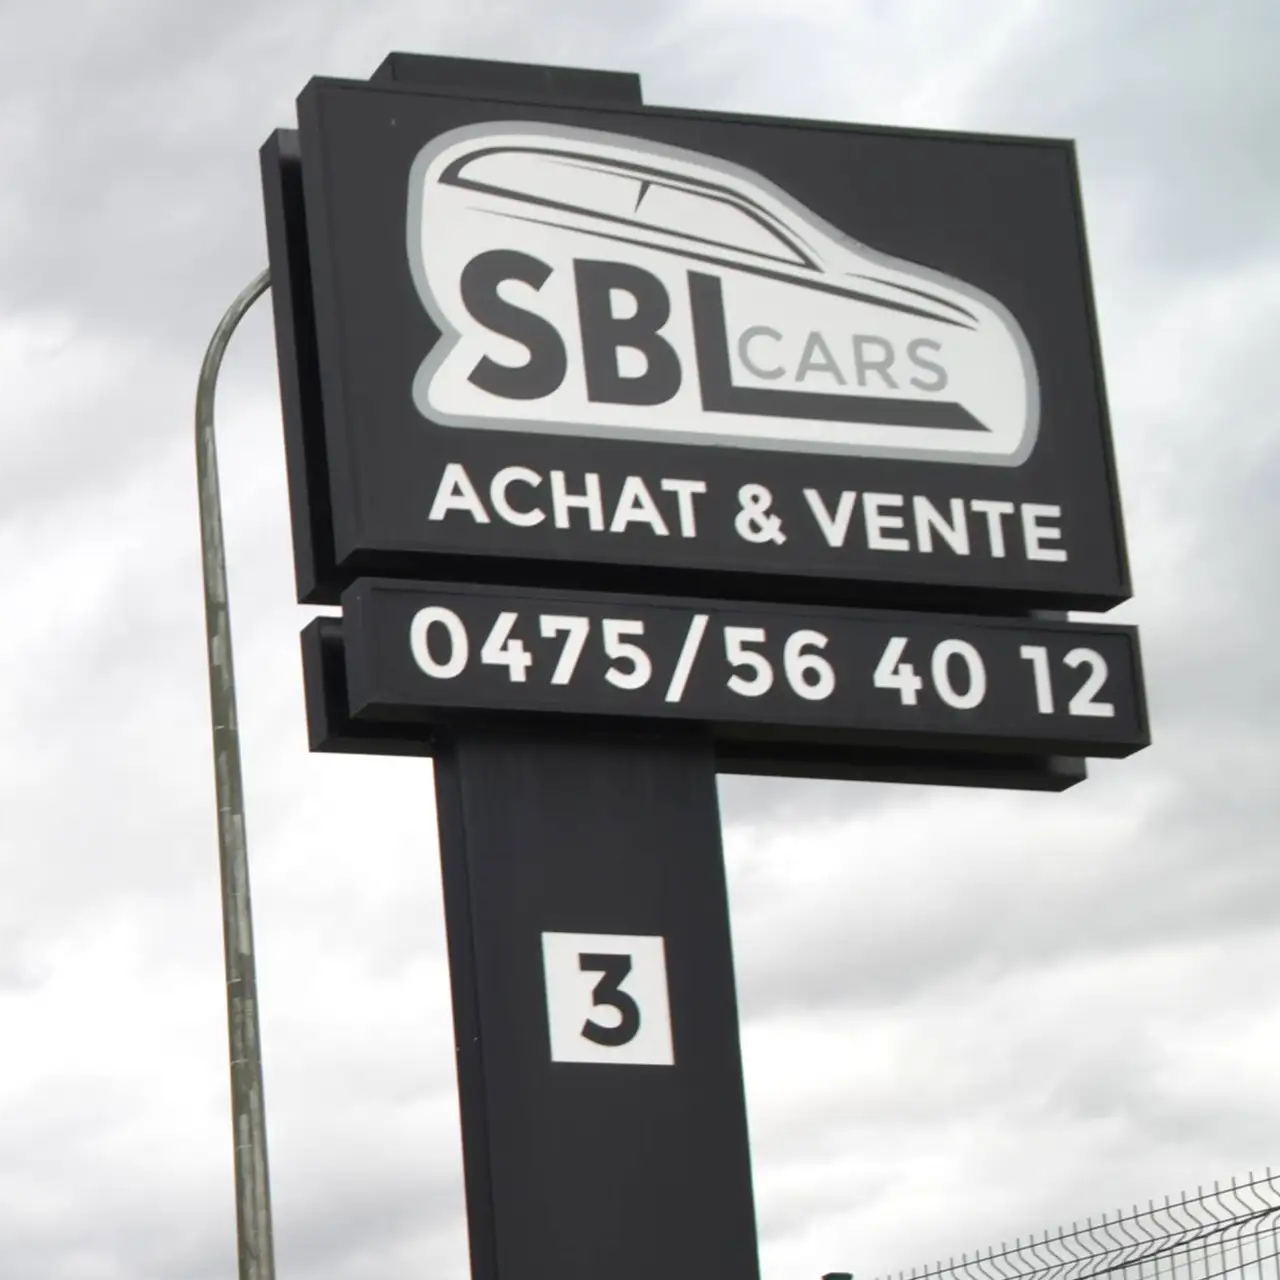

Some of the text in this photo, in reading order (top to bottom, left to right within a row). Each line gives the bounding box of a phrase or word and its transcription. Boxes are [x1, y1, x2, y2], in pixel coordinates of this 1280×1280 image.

[737, 325, 949, 393] CARS
[428, 462, 1068, 562] ACHAT & VENTE
[409, 606, 1115, 718] 0475/56 40 12
[578, 952, 641, 1047] 3
